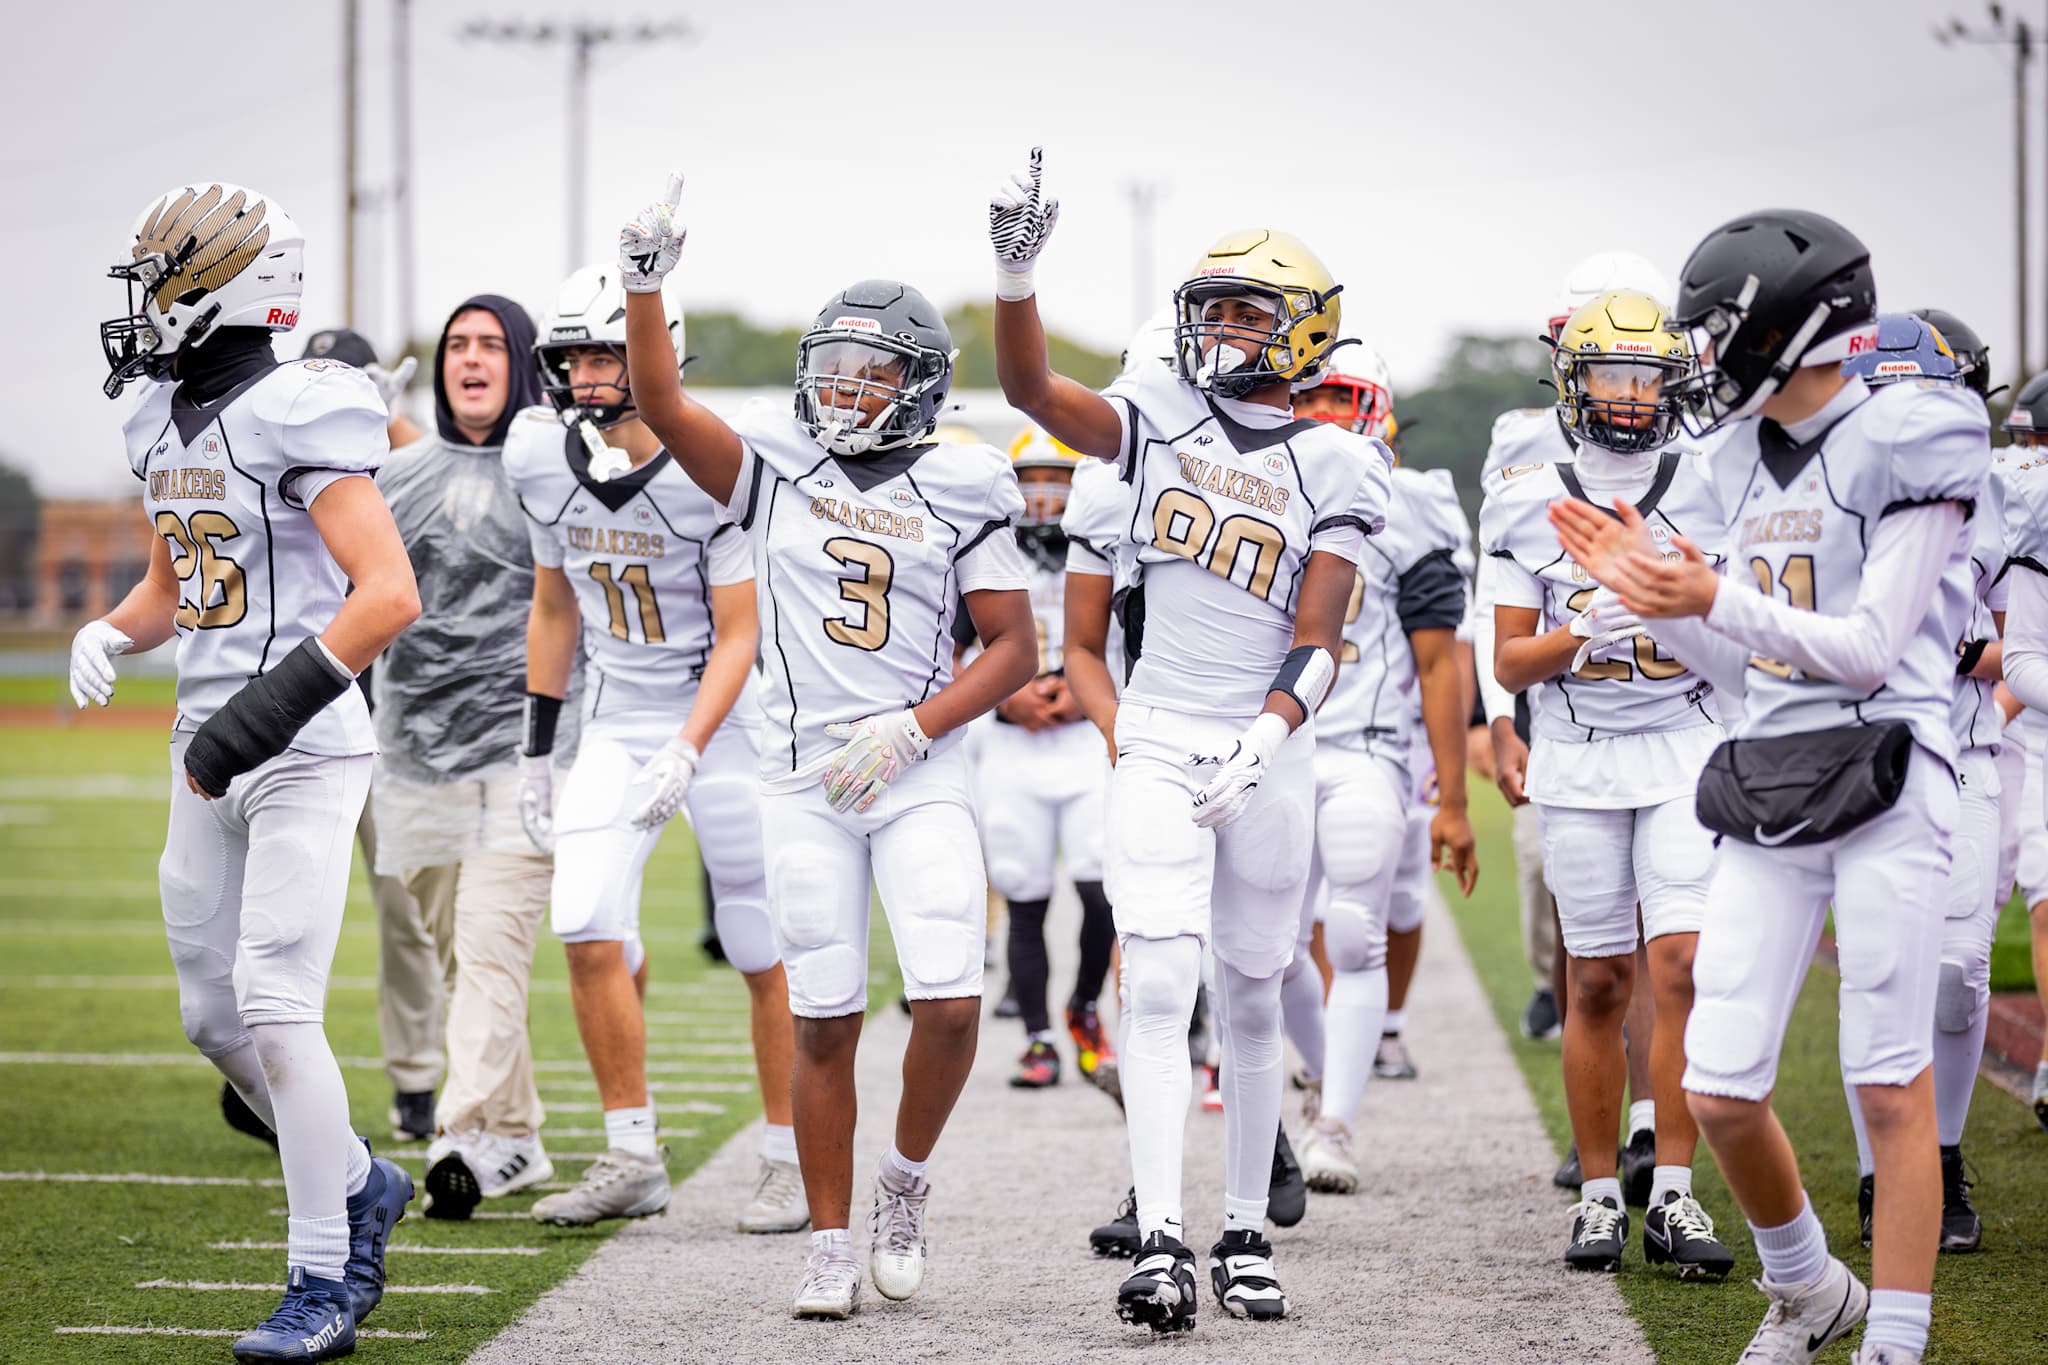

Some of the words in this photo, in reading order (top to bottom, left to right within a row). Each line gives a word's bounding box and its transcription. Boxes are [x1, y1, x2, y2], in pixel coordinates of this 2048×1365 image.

[838, 319, 876, 329] Riddell
[1616, 343, 1652, 353] Riddell
[1881, 364, 1917, 373] Riddell
[150, 467, 226, 503] QUAKERS
[1176, 452, 1290, 516] QUAKERS
[807, 495, 925, 543] QUAKERS
[567, 525, 665, 559] QUAKERS
[155, 510, 248, 634] 26
[588, 561, 667, 644] 11
[822, 536, 895, 652] 3
